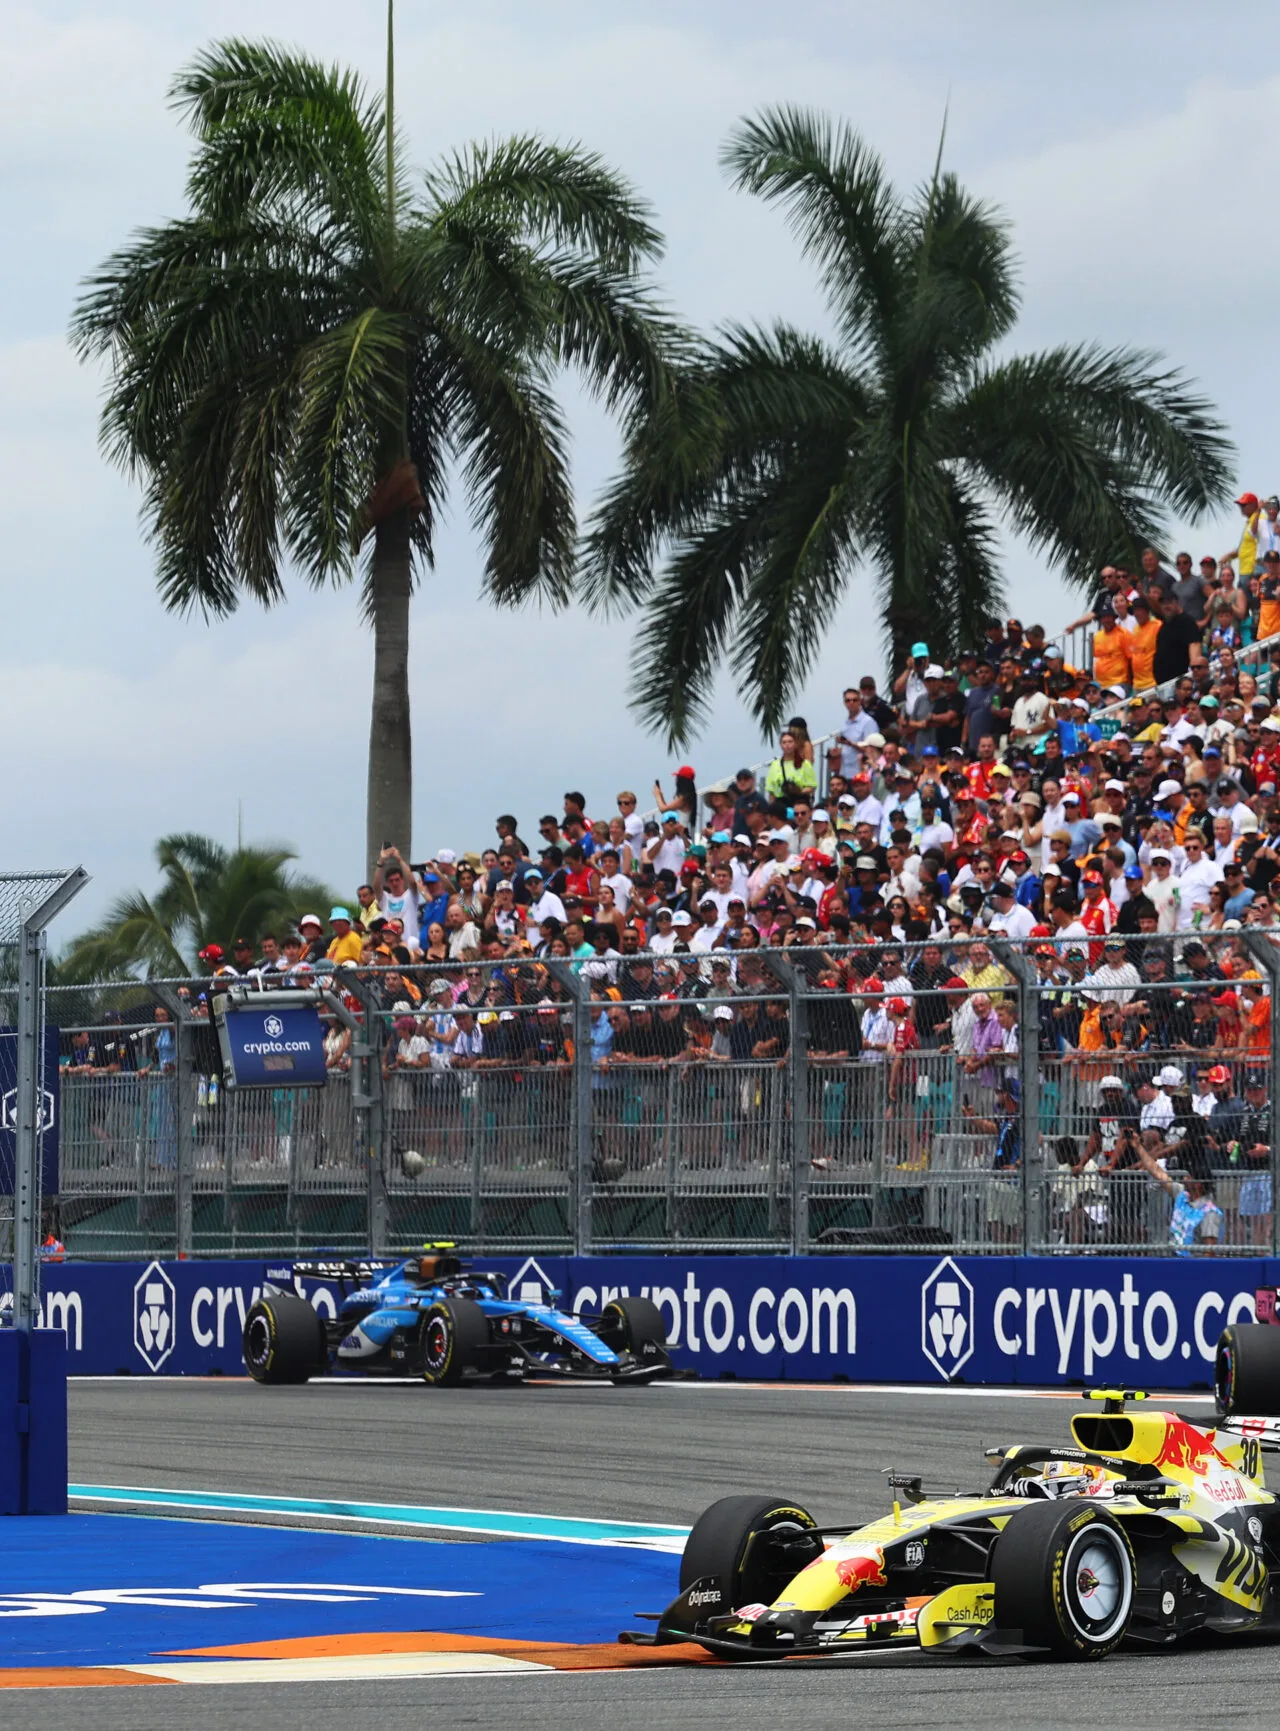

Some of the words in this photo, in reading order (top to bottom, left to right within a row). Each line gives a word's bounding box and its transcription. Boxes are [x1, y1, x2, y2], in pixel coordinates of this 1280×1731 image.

[243, 1041, 310, 1055] crypto.com
[573, 1272, 856, 1354] cpto.com
[1239, 1438, 1258, 1479] 30
[1215, 1532, 1268, 1600] VISA
[947, 1607, 970, 1621] Cash
[972, 1606, 993, 1622] App
